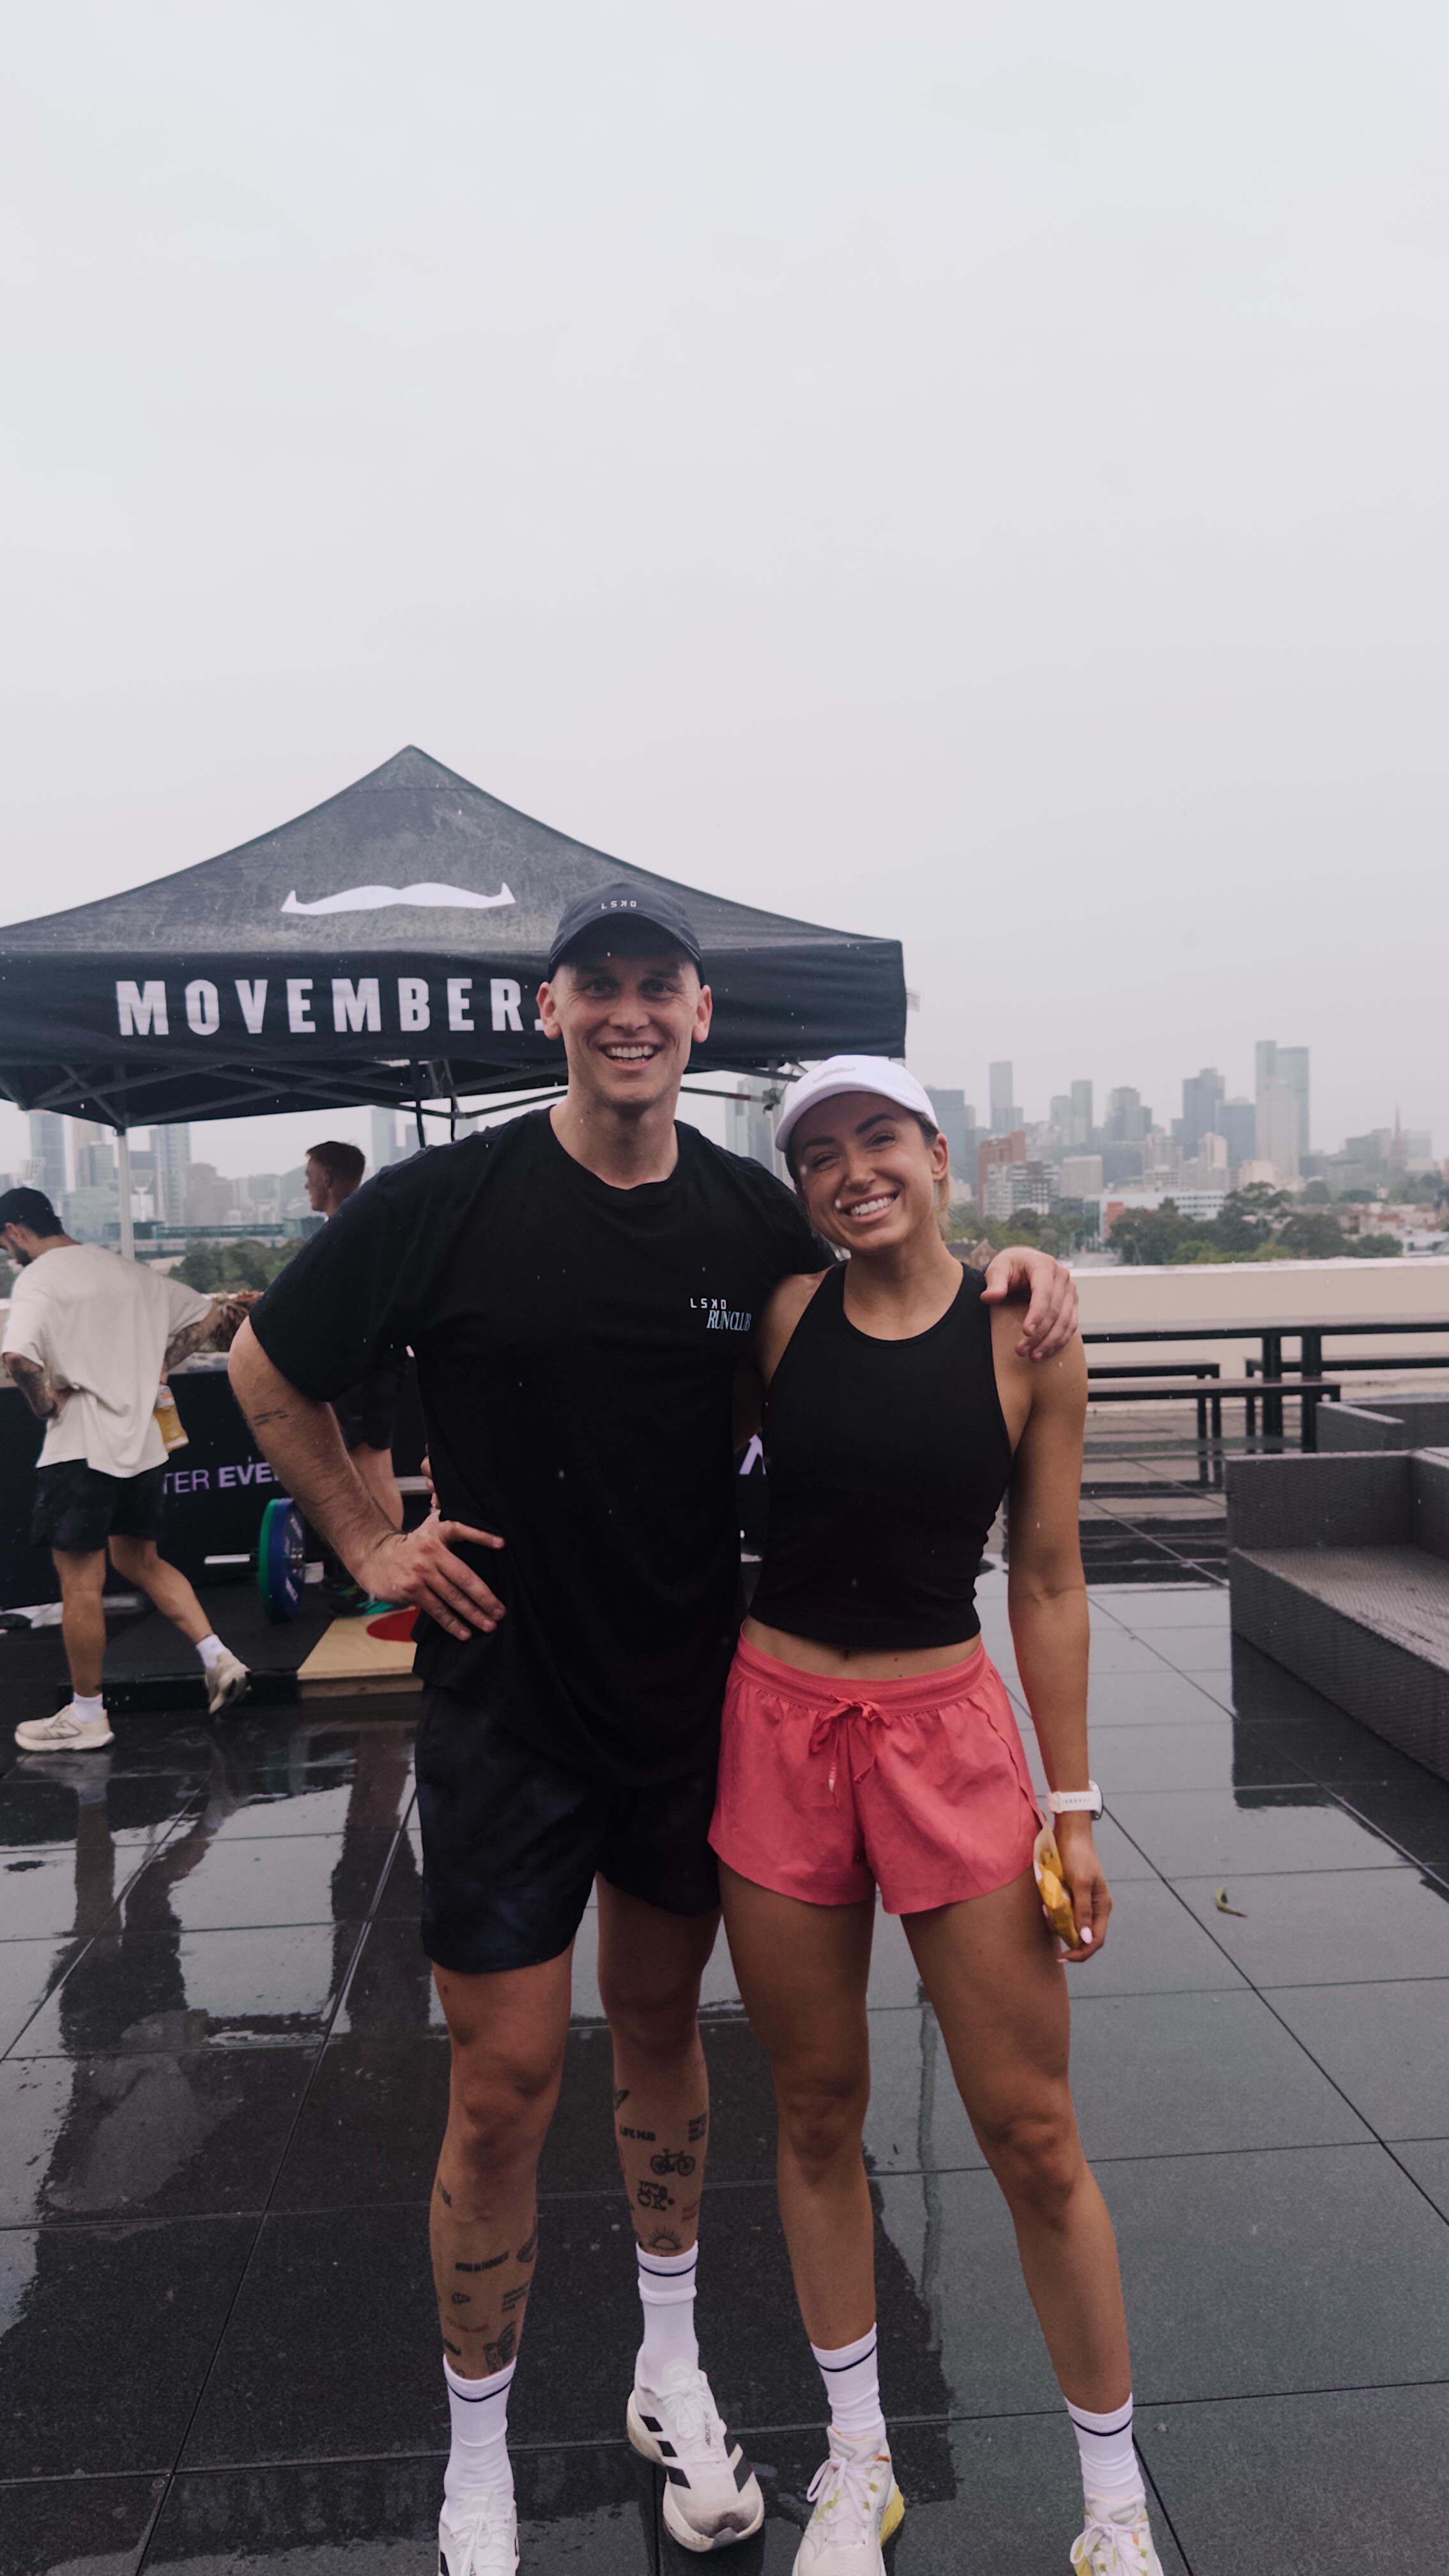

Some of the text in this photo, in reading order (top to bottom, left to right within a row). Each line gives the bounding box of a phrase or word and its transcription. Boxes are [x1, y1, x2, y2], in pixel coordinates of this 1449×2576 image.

[601, 900, 637, 910] LSKD
[690, 1298, 726, 1310] LSKD
[218, 1462, 279, 1488] EVE
